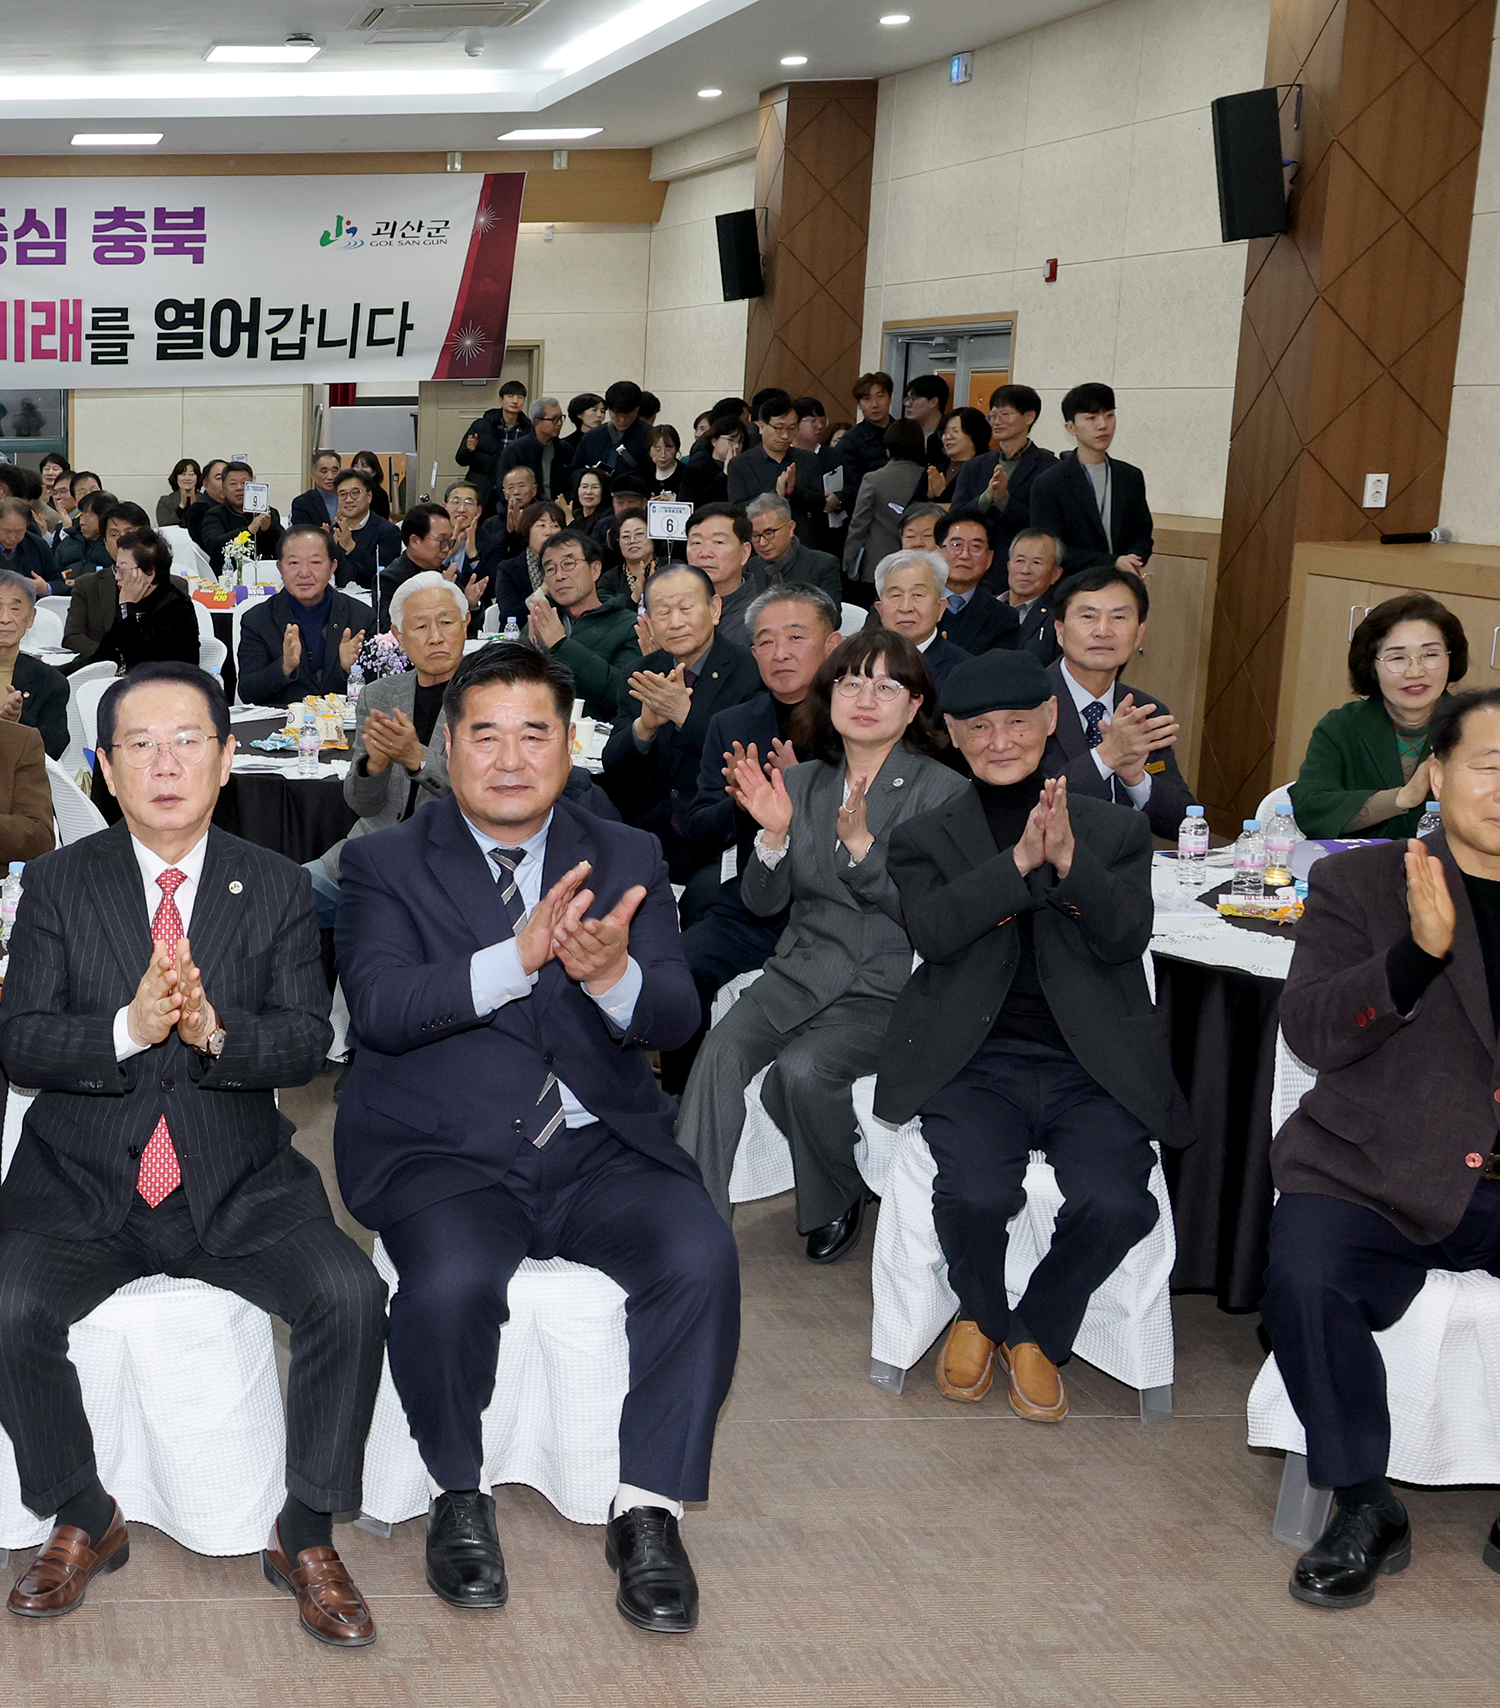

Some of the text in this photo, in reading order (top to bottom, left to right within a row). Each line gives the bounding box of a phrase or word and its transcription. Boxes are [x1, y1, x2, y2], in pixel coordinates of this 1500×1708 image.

[92, 206, 207, 266] 충북
[371, 219, 450, 239] 괴산군
[154, 296, 415, 362] 열어갑니다
[252, 495, 258, 507] 9
[666, 518, 674, 533] 6
